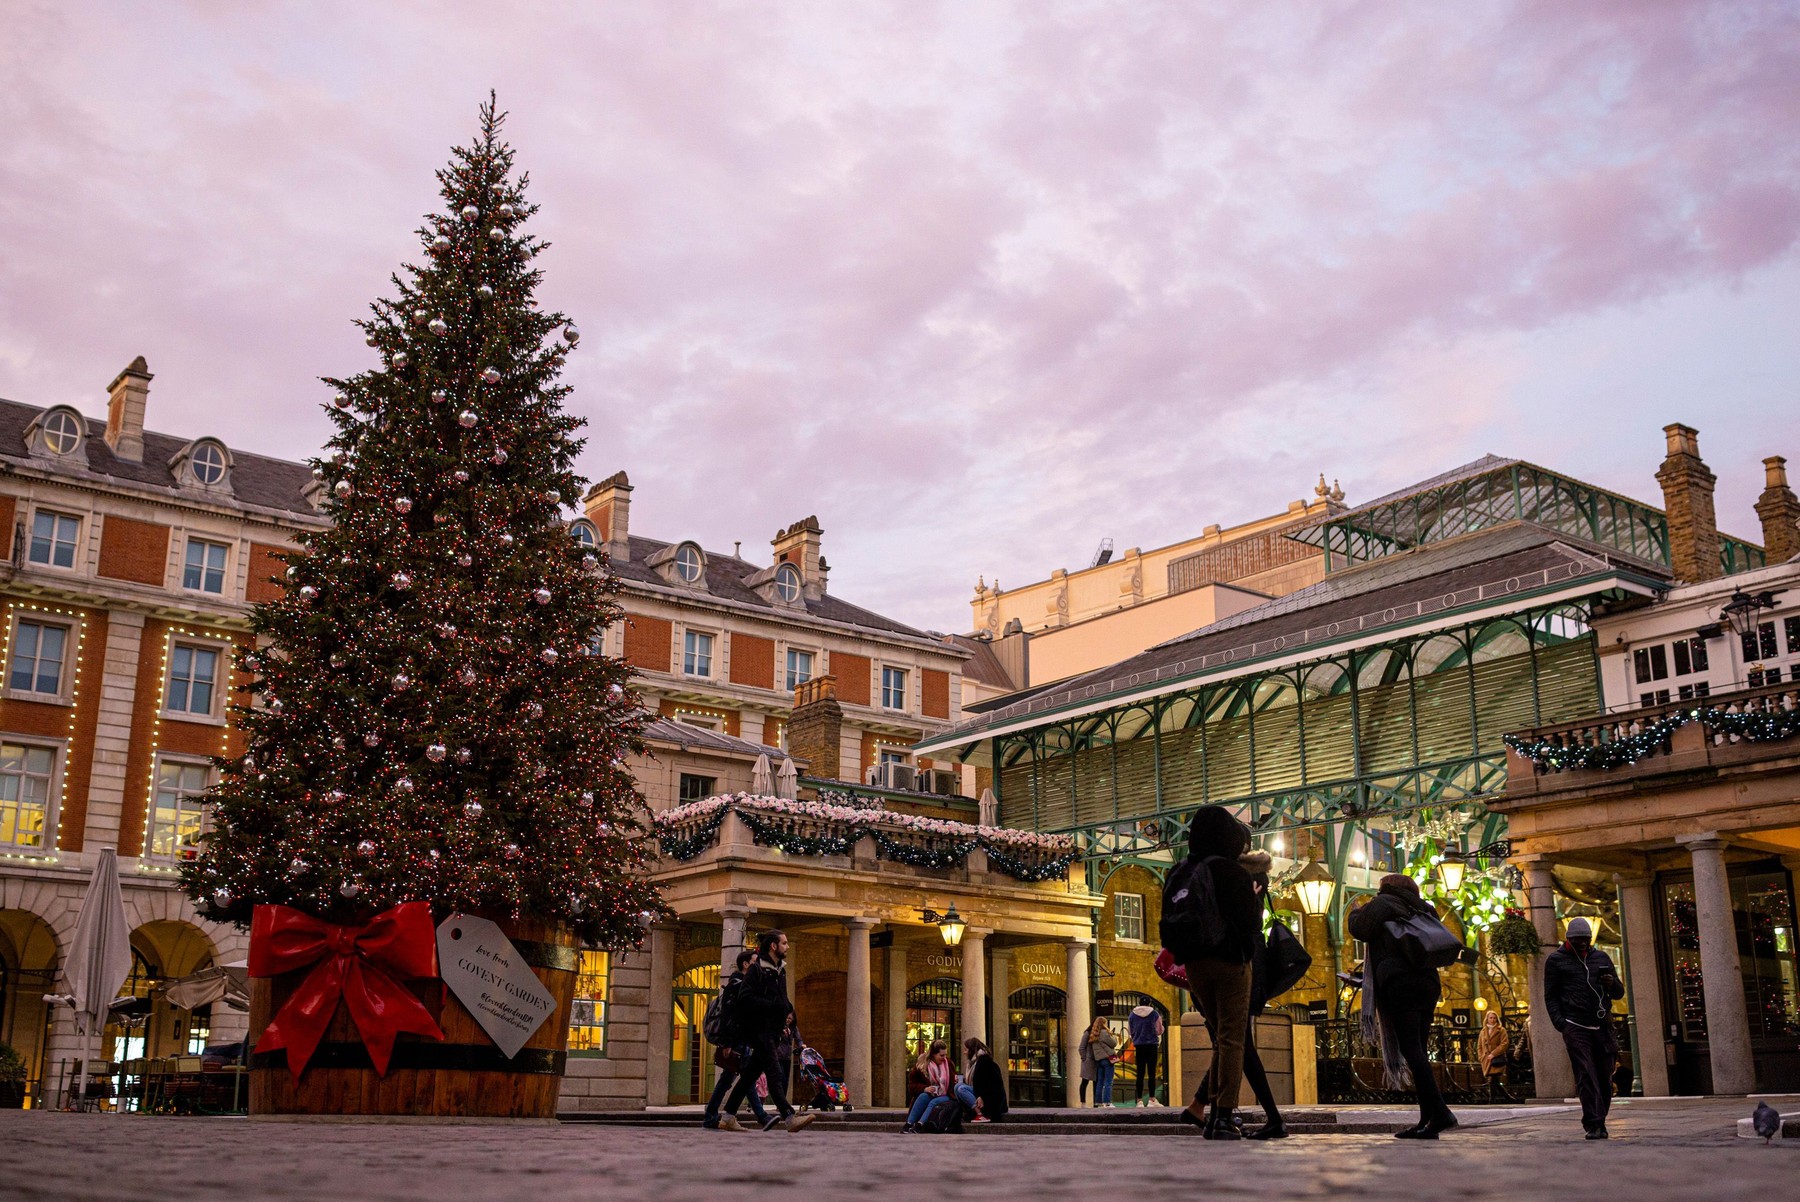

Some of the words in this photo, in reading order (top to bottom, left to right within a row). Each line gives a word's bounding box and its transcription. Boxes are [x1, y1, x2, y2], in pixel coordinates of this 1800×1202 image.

[927, 954, 963, 967] GODIV
[1022, 962, 1062, 975] GODIVA
[458, 958, 505, 988] COVENT
[504, 982, 550, 1010] GARDEN
